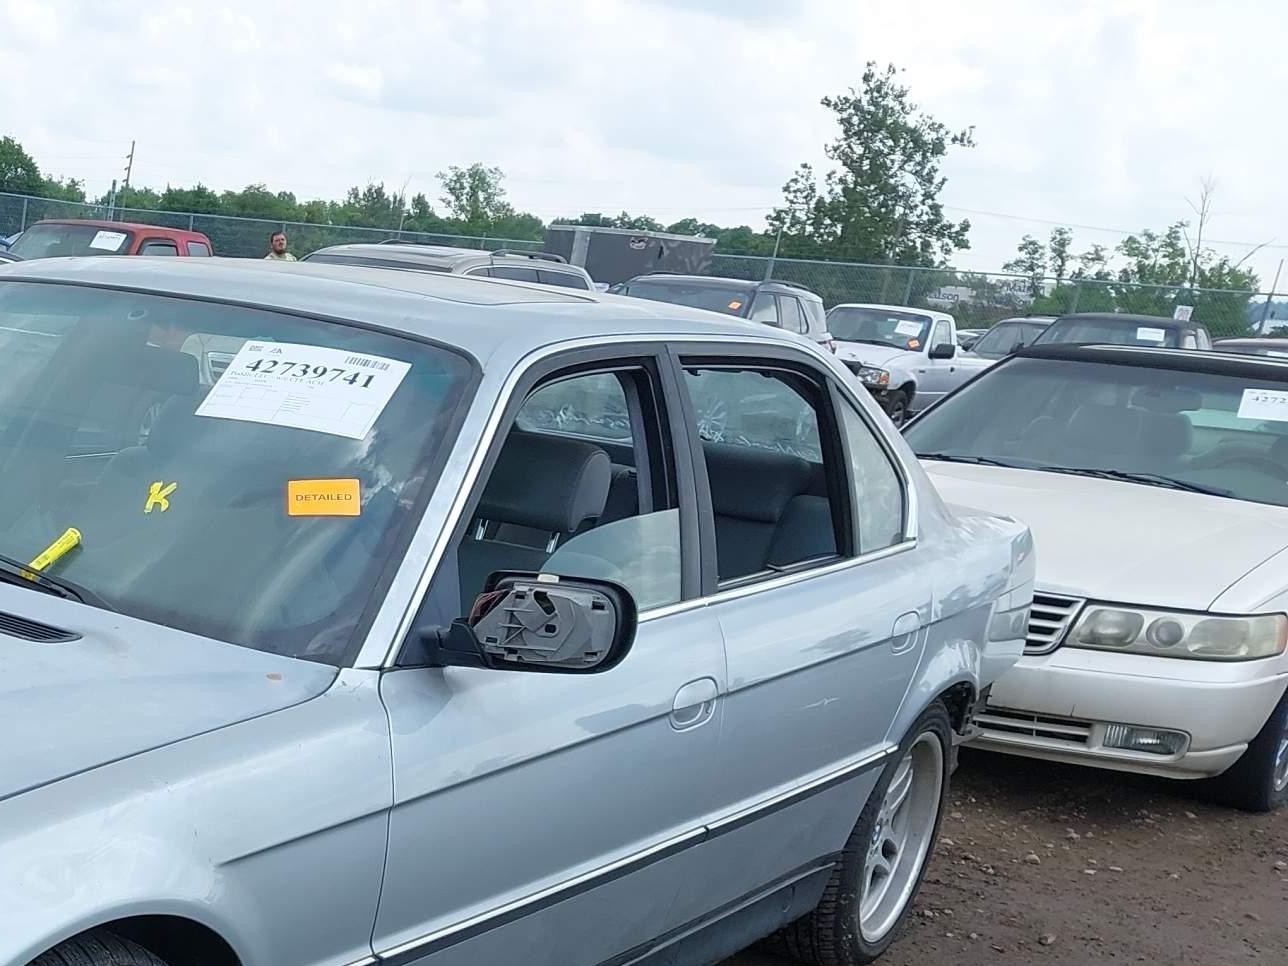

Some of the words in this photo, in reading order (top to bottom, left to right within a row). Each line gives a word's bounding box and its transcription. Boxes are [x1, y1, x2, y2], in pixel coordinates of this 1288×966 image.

[246, 359, 376, 389] 42739741
[144, 480, 178, 513] K
[295, 492, 353, 502] DETAILED
